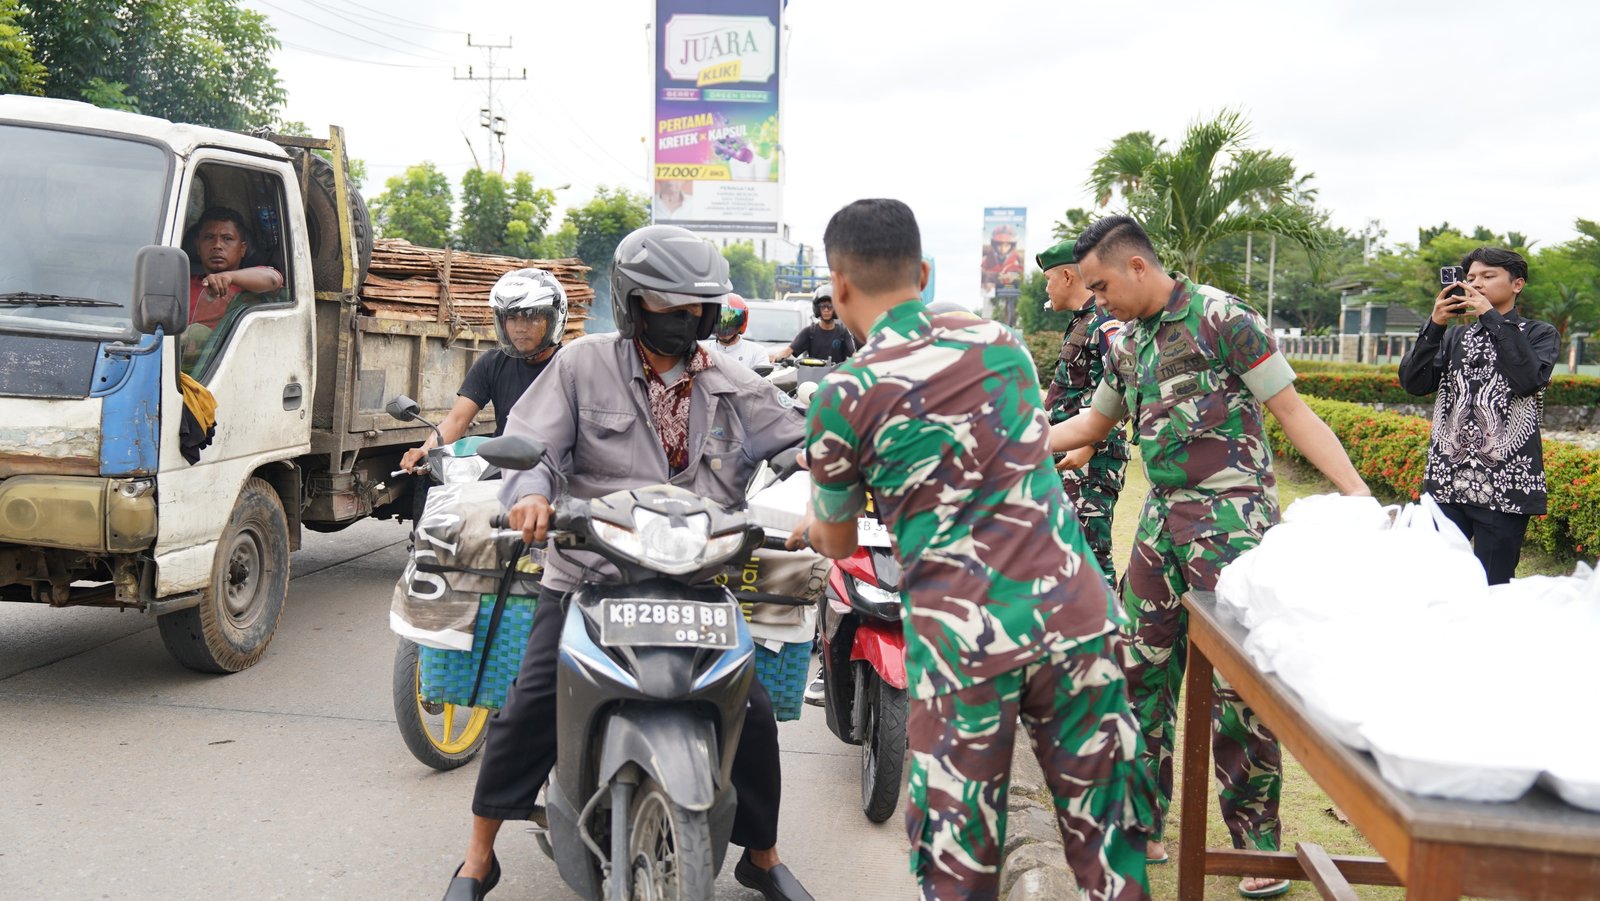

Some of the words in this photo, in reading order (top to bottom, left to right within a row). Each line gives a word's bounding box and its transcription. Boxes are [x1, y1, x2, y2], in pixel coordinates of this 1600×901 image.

[680, 29, 759, 65] JUARA
[703, 63, 738, 81] KLIK!
[658, 112, 713, 134] PERTAMA
[659, 132, 698, 150] KRETEK
[708, 124, 747, 141] KAPSUL
